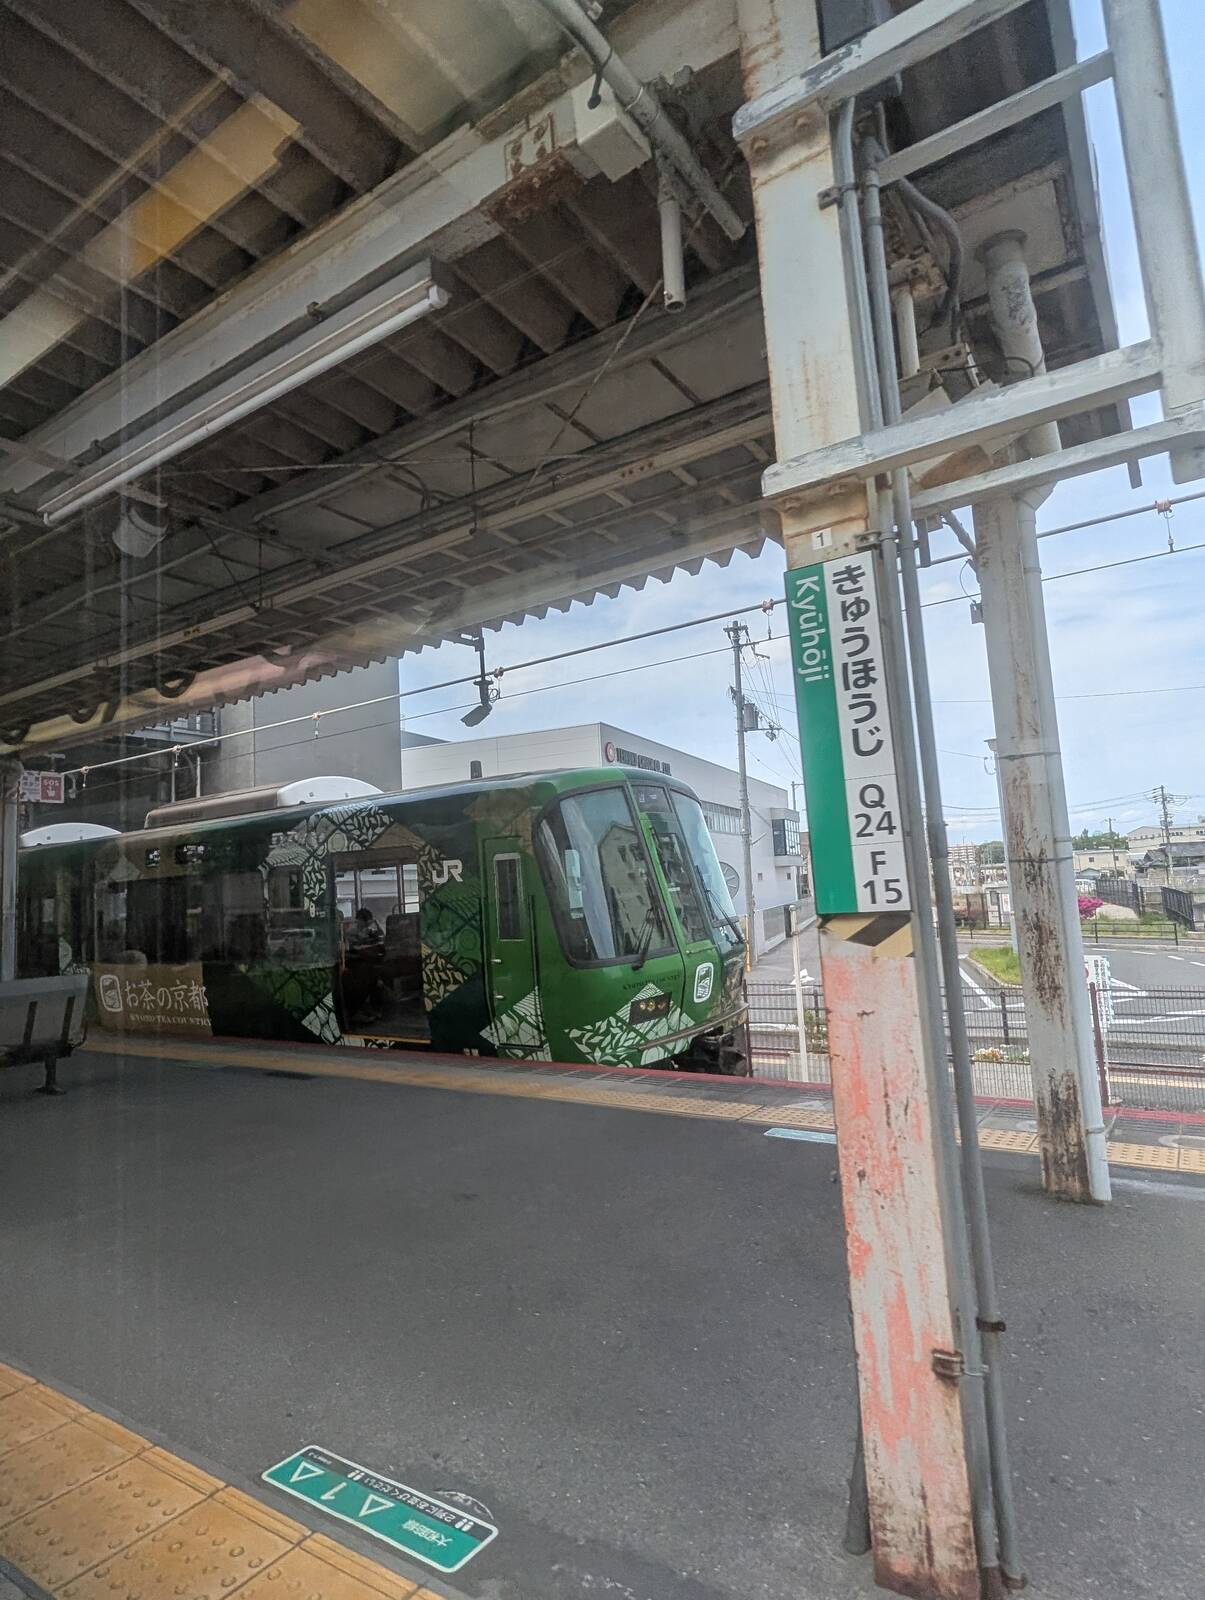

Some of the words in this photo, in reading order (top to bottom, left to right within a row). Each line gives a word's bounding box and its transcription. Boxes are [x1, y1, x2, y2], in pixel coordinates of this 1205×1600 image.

[816, 531, 826, 548] 1
[791, 575, 830, 683] Kyūhōji
[831, 563, 885, 758] きゅうほうじ
[859, 783, 885, 810] Q
[855, 811, 897, 838] 24
[432, 859, 464, 884] JR
[870, 851, 886, 876] F
[863, 879, 904, 905] 15
[125, 979, 209, 1013] お茶の京都
[320, 1482, 347, 1500] 1
